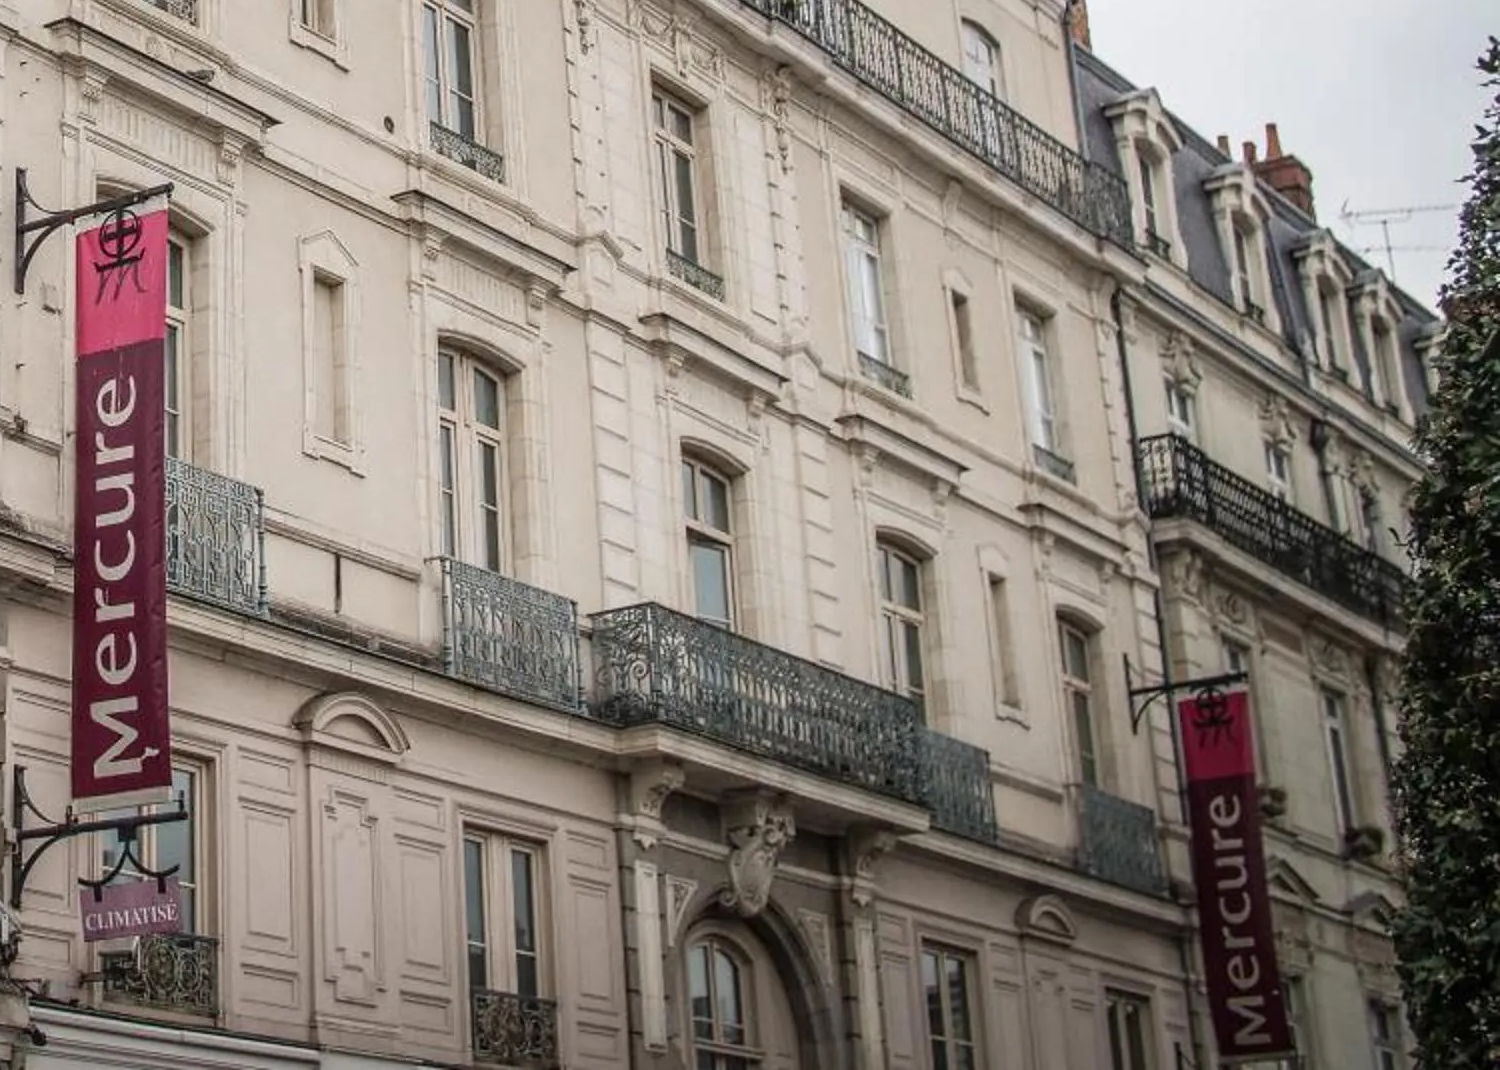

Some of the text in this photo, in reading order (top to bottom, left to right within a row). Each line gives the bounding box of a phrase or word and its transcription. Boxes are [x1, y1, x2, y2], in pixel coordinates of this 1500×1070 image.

[89, 373, 141, 780] Mercure
[85, 898, 179, 931] CLIMATISÉ
[1209, 794, 1271, 1046] Mercure
